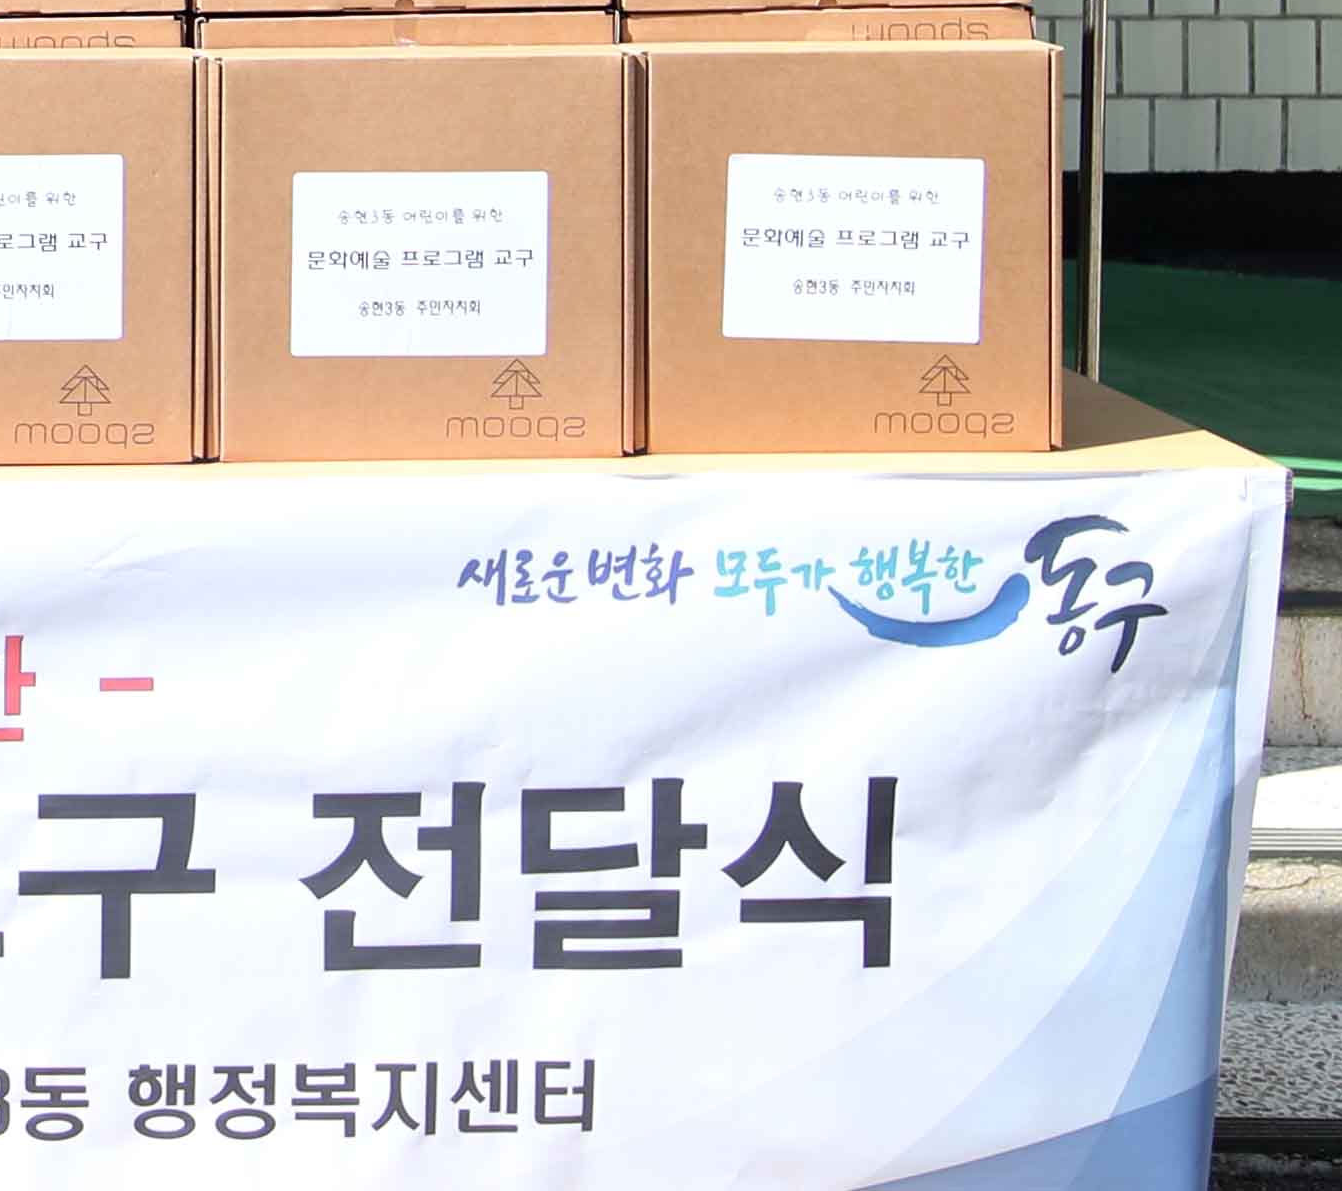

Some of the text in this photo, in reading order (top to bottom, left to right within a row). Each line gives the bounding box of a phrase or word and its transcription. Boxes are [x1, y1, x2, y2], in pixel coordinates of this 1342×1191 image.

[45, 191, 77, 207] 위한
[773, 187, 939, 206] 송현3동 어린이를 위한
[339, 208, 503, 226] 송현3동 어린이를 위한
[67, 232, 108, 251] 교구
[742, 228, 970, 250] 문화예술 프로그램 교구
[308, 249, 533, 270] 문화예술 프로그램 교구
[794, 278, 916, 296] 송현3동 주민자치회
[358, 299, 481, 317] 송현3동 주민자치회
[457, 513, 1170, 675] 새로운 변화 모두가 행복한 동구
[310, 776, 899, 972] 전달식
[128, 1059, 596, 1138] 행정복지센터
